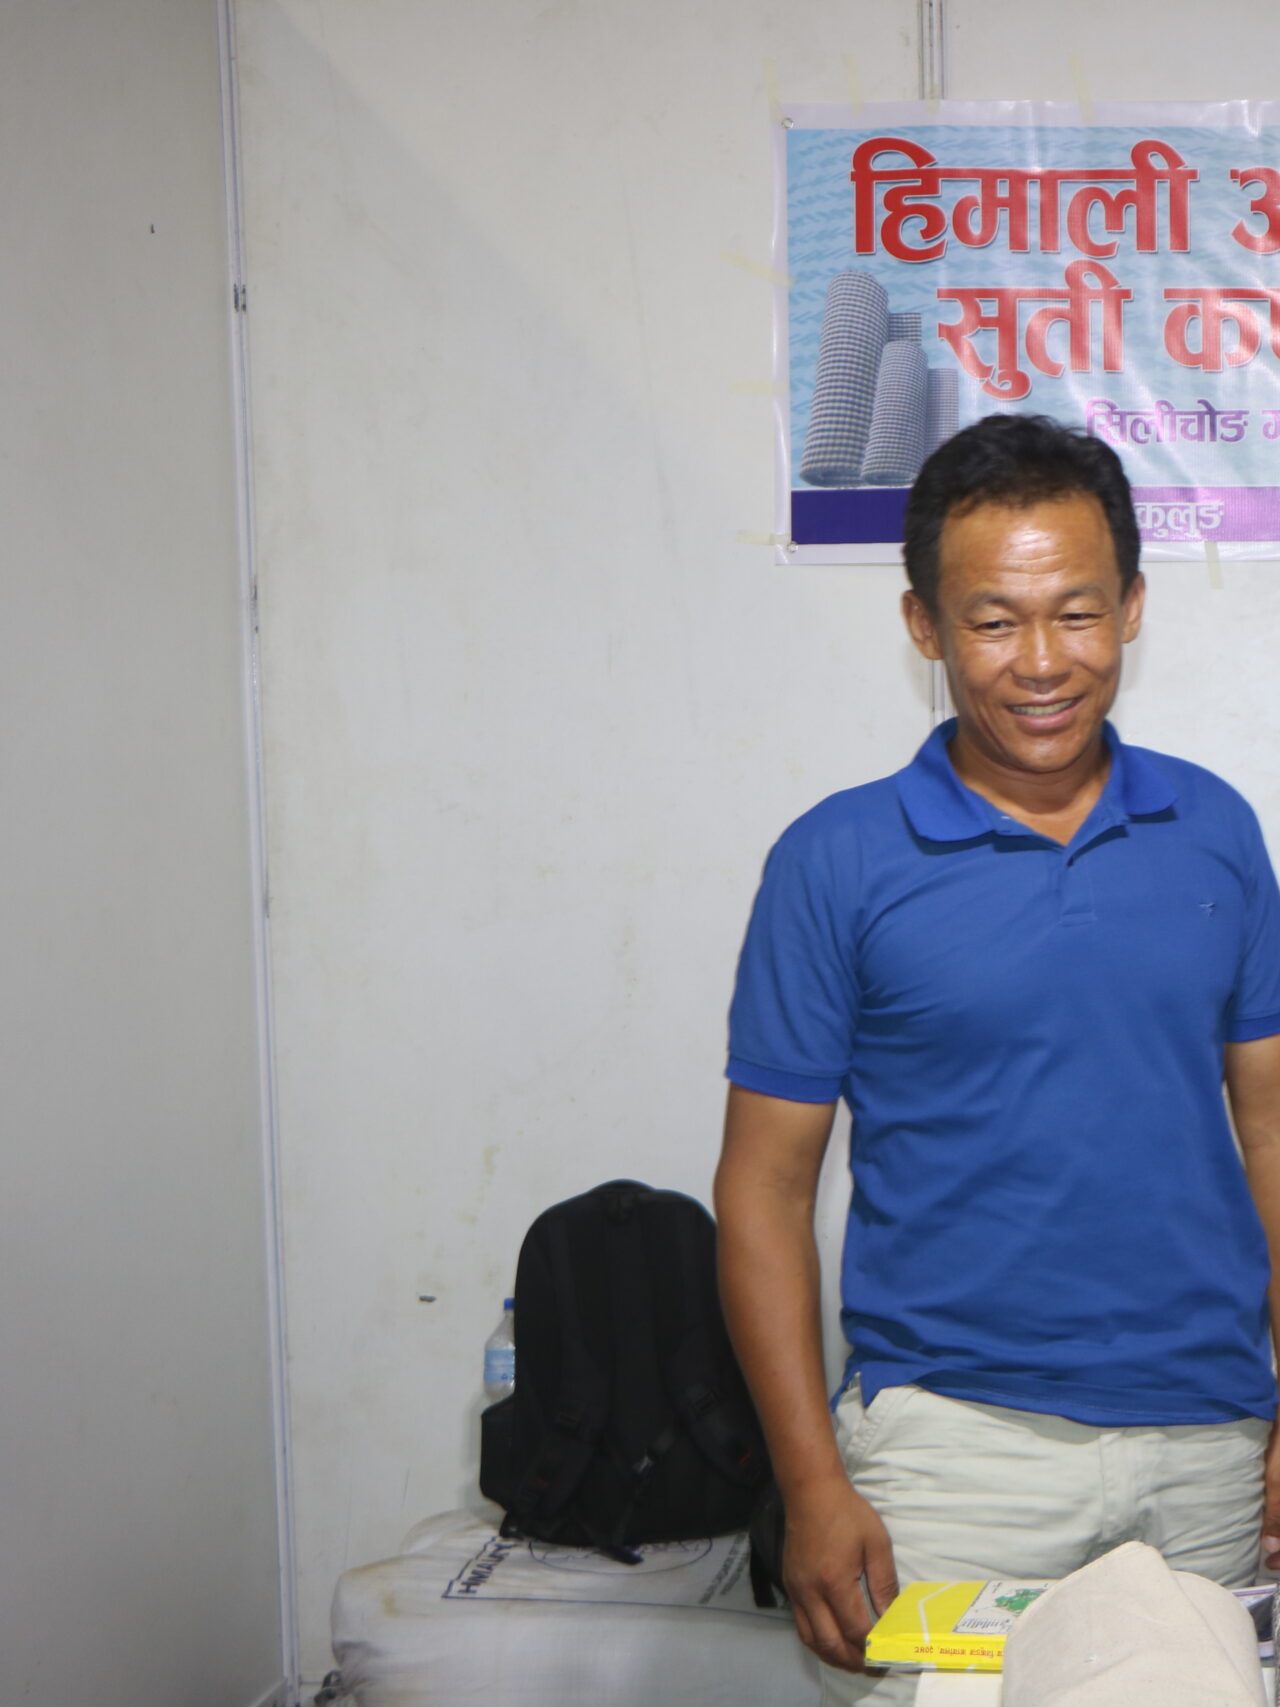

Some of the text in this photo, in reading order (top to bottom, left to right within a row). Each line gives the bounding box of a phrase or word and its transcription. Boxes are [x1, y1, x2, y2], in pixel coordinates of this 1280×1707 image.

[851, 137, 1199, 263] हिमाली
[937, 259, 1132, 400] सुती
[1086, 399, 1250, 445] सिलीचोङ
